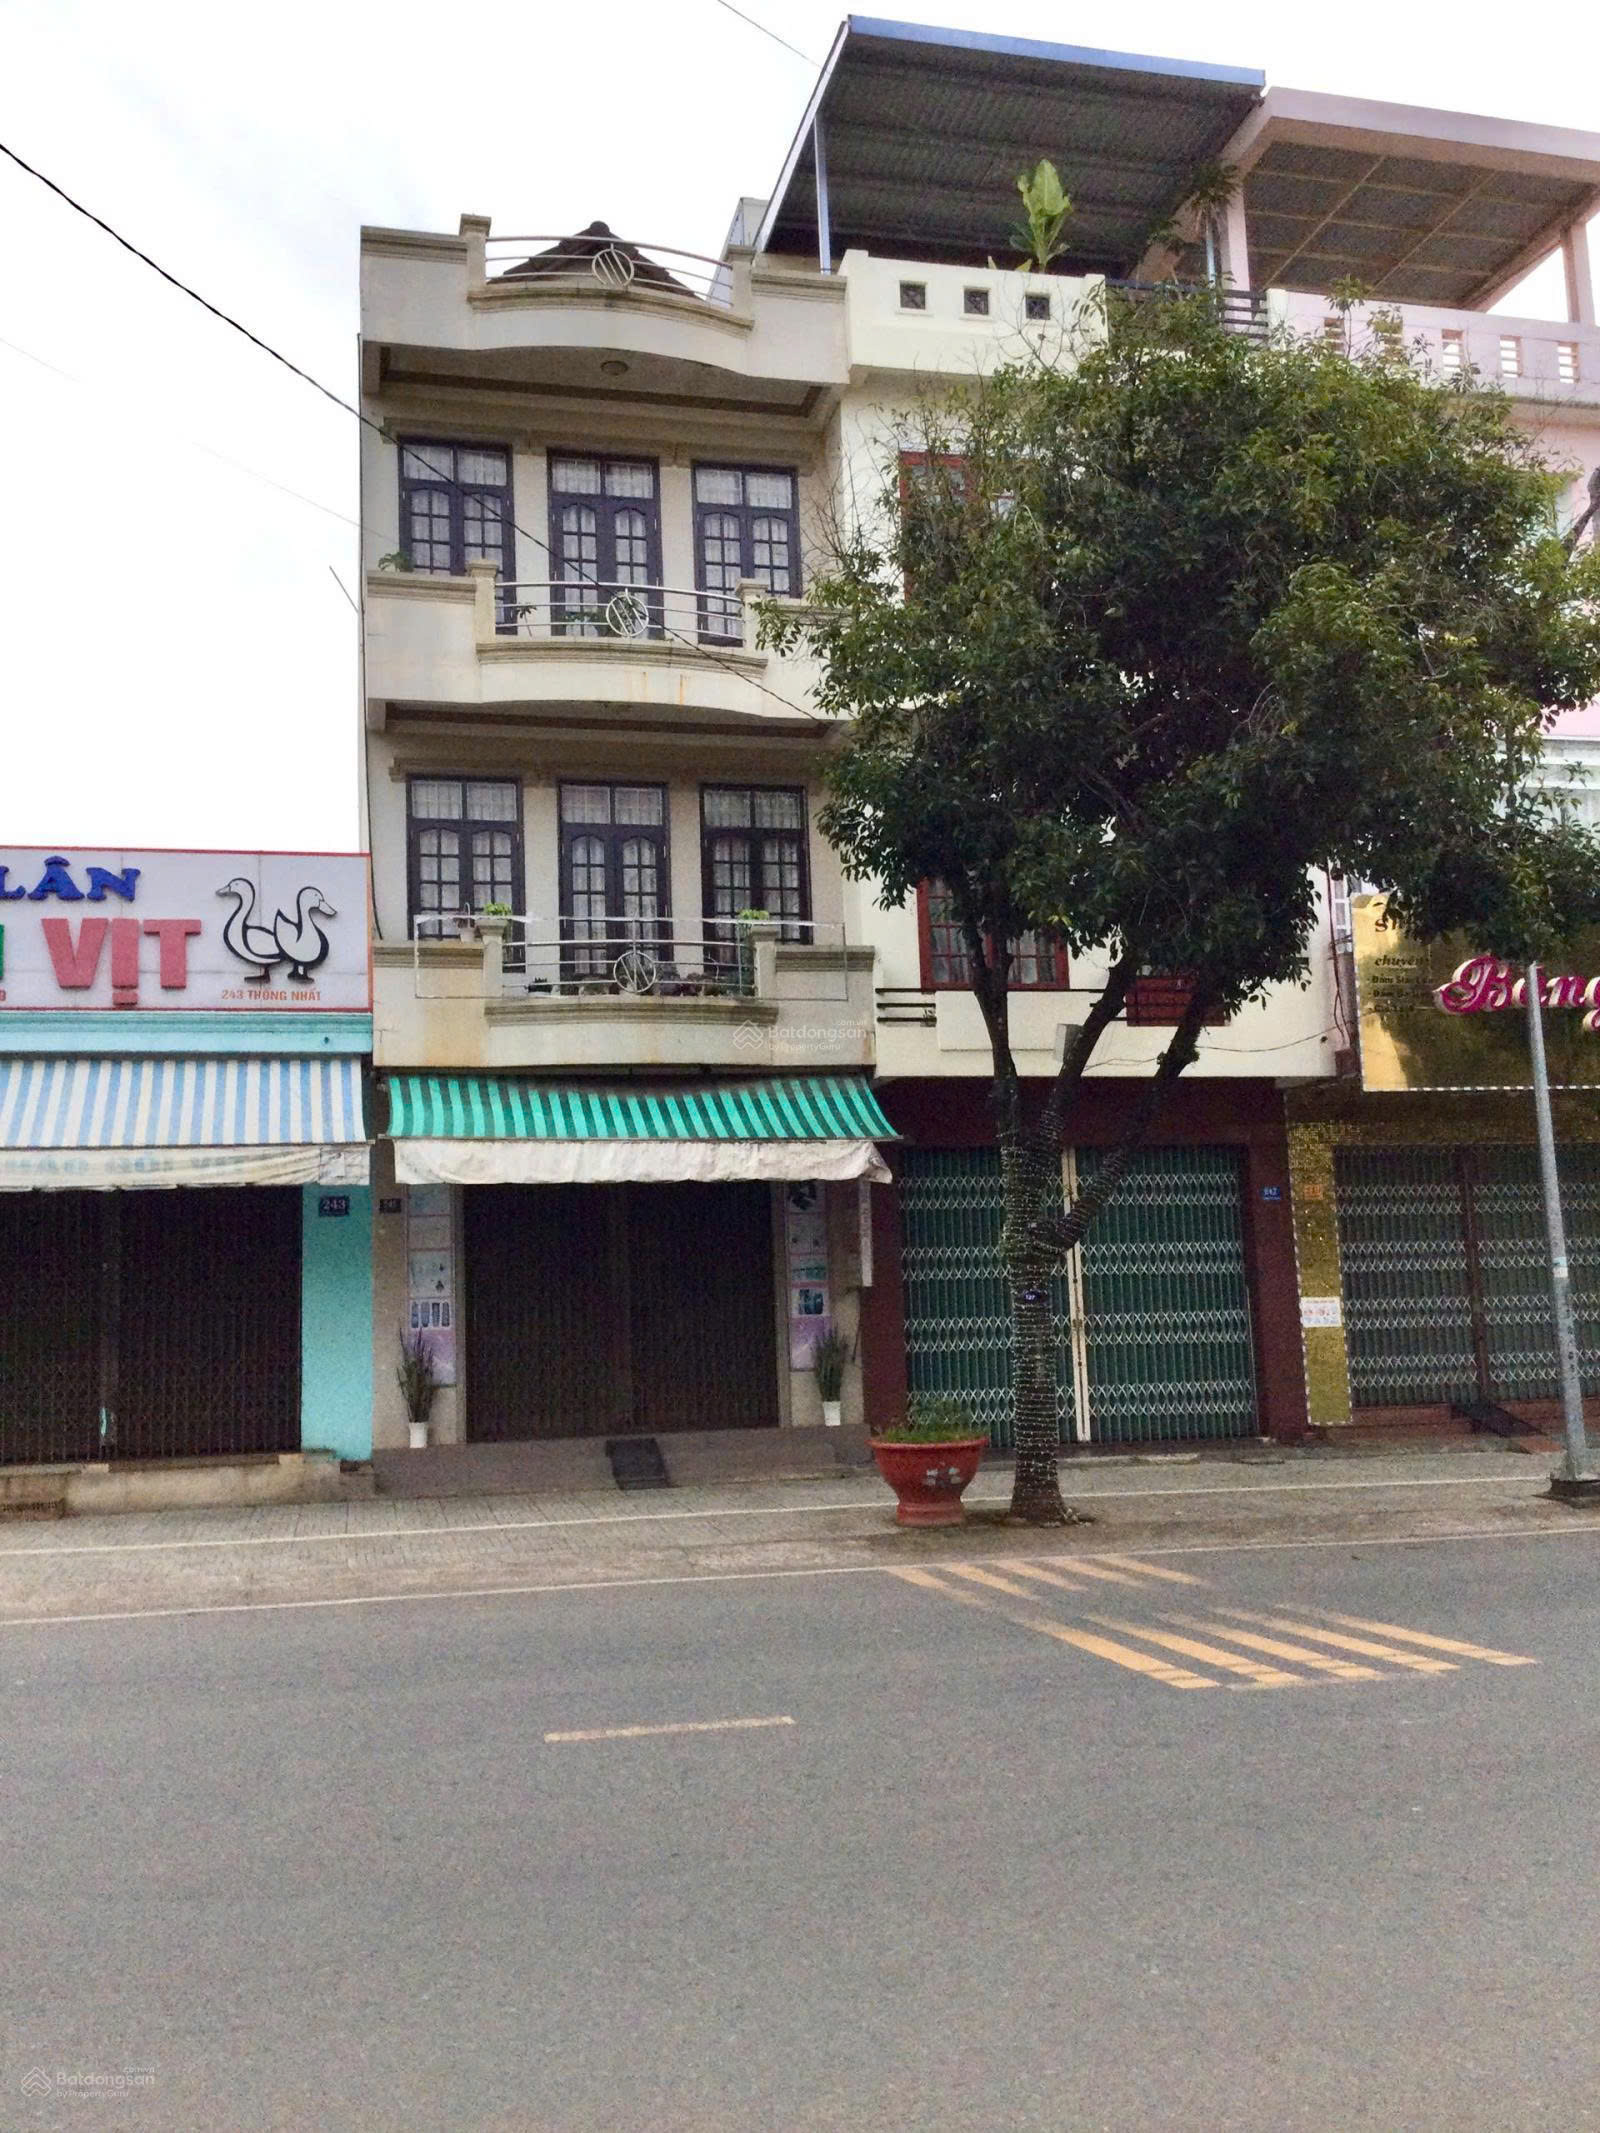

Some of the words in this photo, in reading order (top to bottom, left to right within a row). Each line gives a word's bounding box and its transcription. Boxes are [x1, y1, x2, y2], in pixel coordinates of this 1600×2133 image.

[0, 856, 141, 902] LÂN
[41, 918, 201, 1005] VỊT
[222, 989, 243, 999] 243
[323, 1200, 346, 1210] 243
